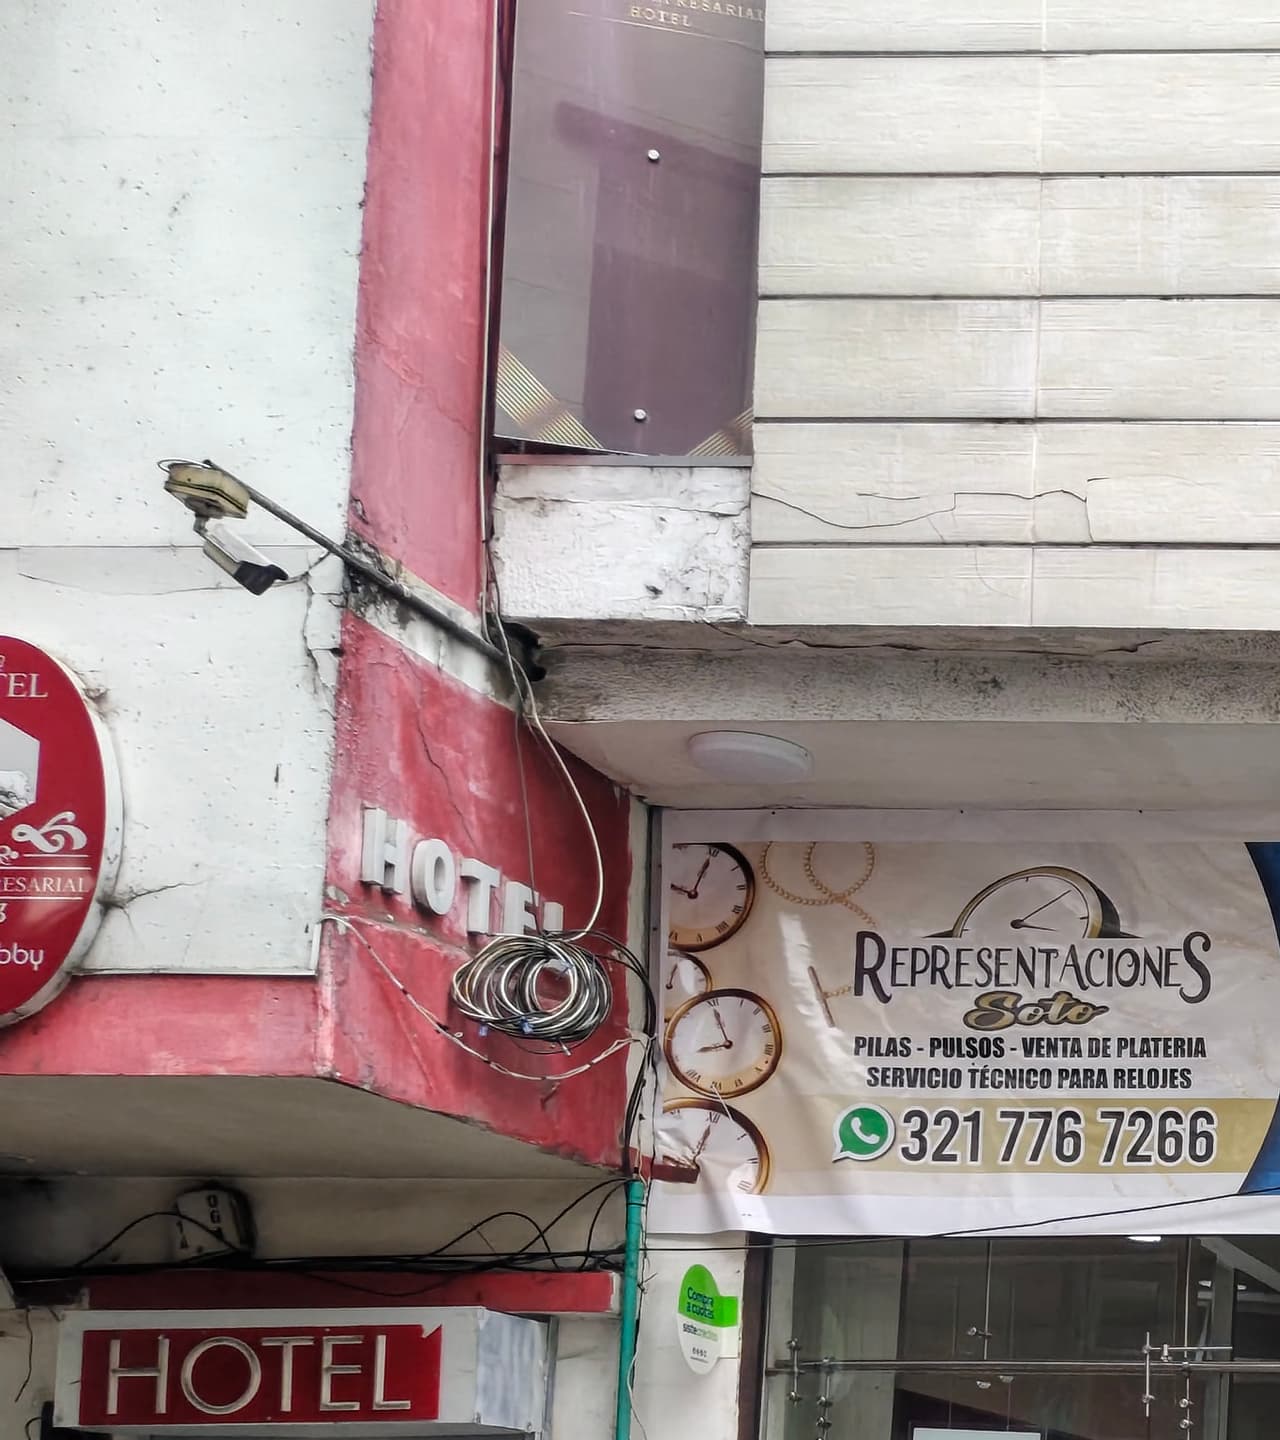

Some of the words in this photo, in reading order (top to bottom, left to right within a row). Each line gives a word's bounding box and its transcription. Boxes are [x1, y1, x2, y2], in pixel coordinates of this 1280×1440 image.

[630, 6, 692, 27] HOTEL
[853, 930, 1212, 1005] REPRESENTACIONES
[962, 990, 1110, 1032] Soto
[853, 1036, 912, 1059] PILAS
[928, 1036, 1004, 1060] PULSOS
[1021, 1036, 1083, 1059] VENTA
[1087, 1036, 1112, 1058] DE
[1114, 1036, 1208, 1059] PLATERIA
[866, 1066, 962, 1089] SERVICIO
[969, 1063, 1052, 1089] TÉCNICO
[1057, 1067, 1108, 1088] PARA
[1112, 1067, 1193, 1089] RELOJES
[901, 1108, 982, 1165] 321
[996, 1108, 1083, 1165] 776
[1099, 1108, 1216, 1166] 7266
[106, 1334, 412, 1416] HOTEL
